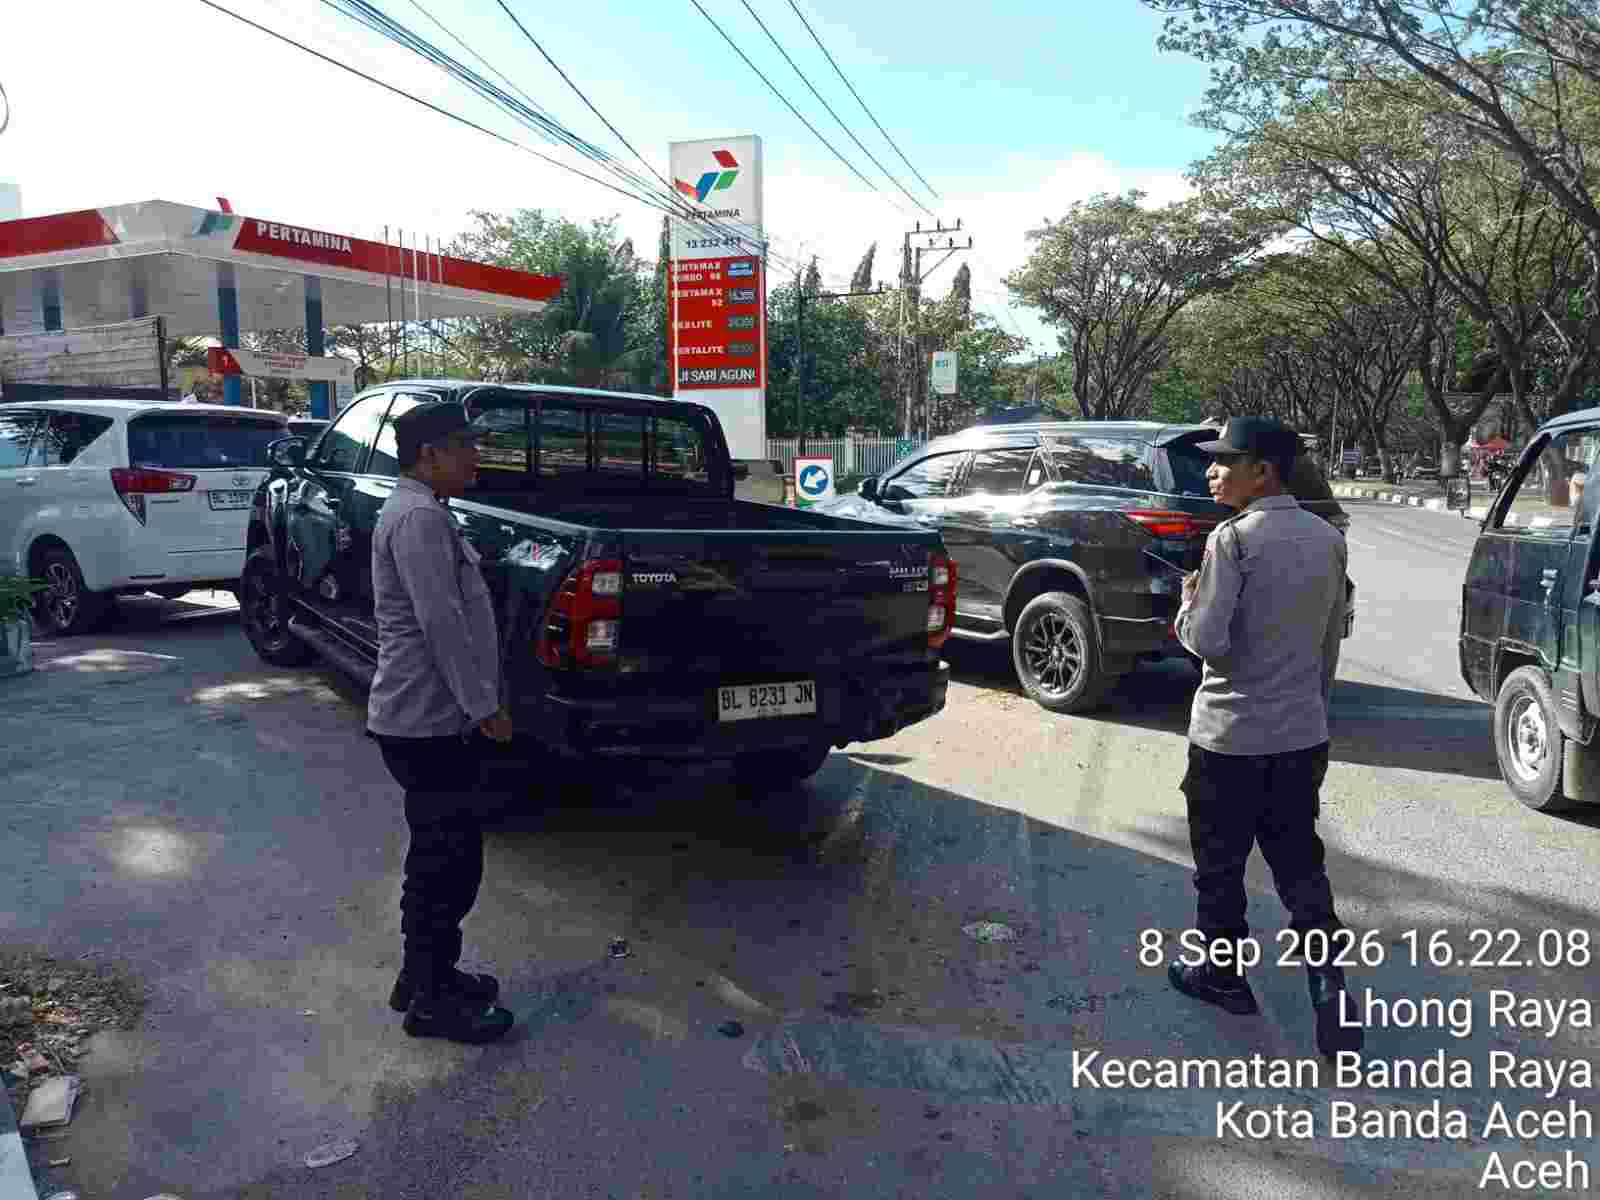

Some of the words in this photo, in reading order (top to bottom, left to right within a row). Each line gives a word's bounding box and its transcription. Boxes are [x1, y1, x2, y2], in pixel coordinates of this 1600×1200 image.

[685, 208, 741, 219] PERTAMINA
[256, 221, 352, 254] PERTAMINA
[690, 368, 717, 381] SARI
[632, 572, 679, 584] TOYOTA
[721, 689, 742, 710] BL
[750, 686, 787, 707] 8231
[794, 683, 814, 703] JN
